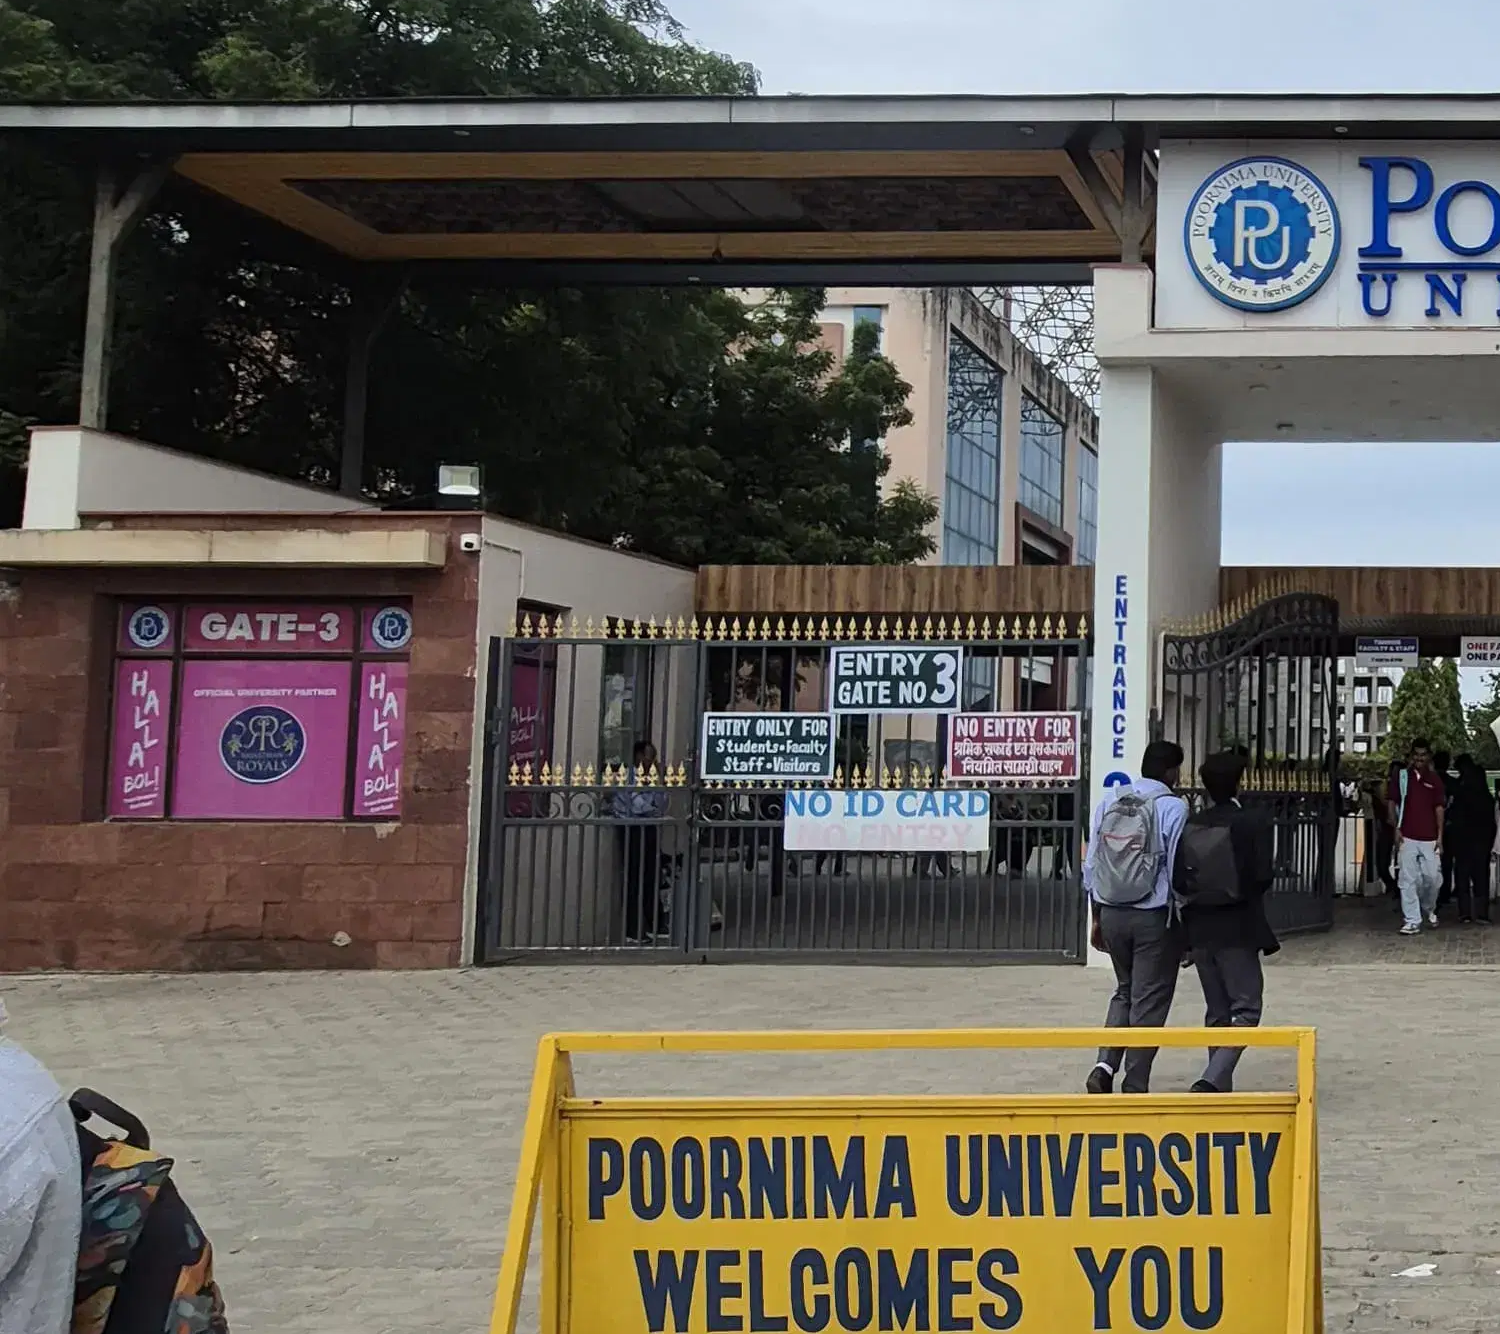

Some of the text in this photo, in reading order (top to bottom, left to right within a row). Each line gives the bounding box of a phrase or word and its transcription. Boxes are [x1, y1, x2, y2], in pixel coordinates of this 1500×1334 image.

[1192, 165, 1332, 238] POORNIMA UNIVERSITY
[1233, 199, 1291, 271] PU
[200, 612, 341, 643] GATE-3
[1466, 642, 1489, 651] ONE
[1466, 652, 1489, 661] ONE
[838, 652, 927, 677] ENTRY
[838, 652, 957, 705] GATE NO 3
[1112, 575, 1128, 759] ENTRANCE
[237, 688, 293, 697] UNIVERSITY
[295, 688, 337, 697] PARTNER
[708, 717, 828, 738] ENTRY ONLY FOR
[956, 717, 1071, 737] NO ENTRY FOR
[123, 765, 160, 794] BOL!
[237, 759, 288, 772] ROYALS
[363, 768, 400, 797] BOL!
[785, 790, 990, 818] NO ID CARD
[860, 823, 974, 849] ENTRY
[587, 1131, 1283, 1221] POORNIMA UNIVERSITY
[634, 1244, 1225, 1334] WELCOMES YOU
